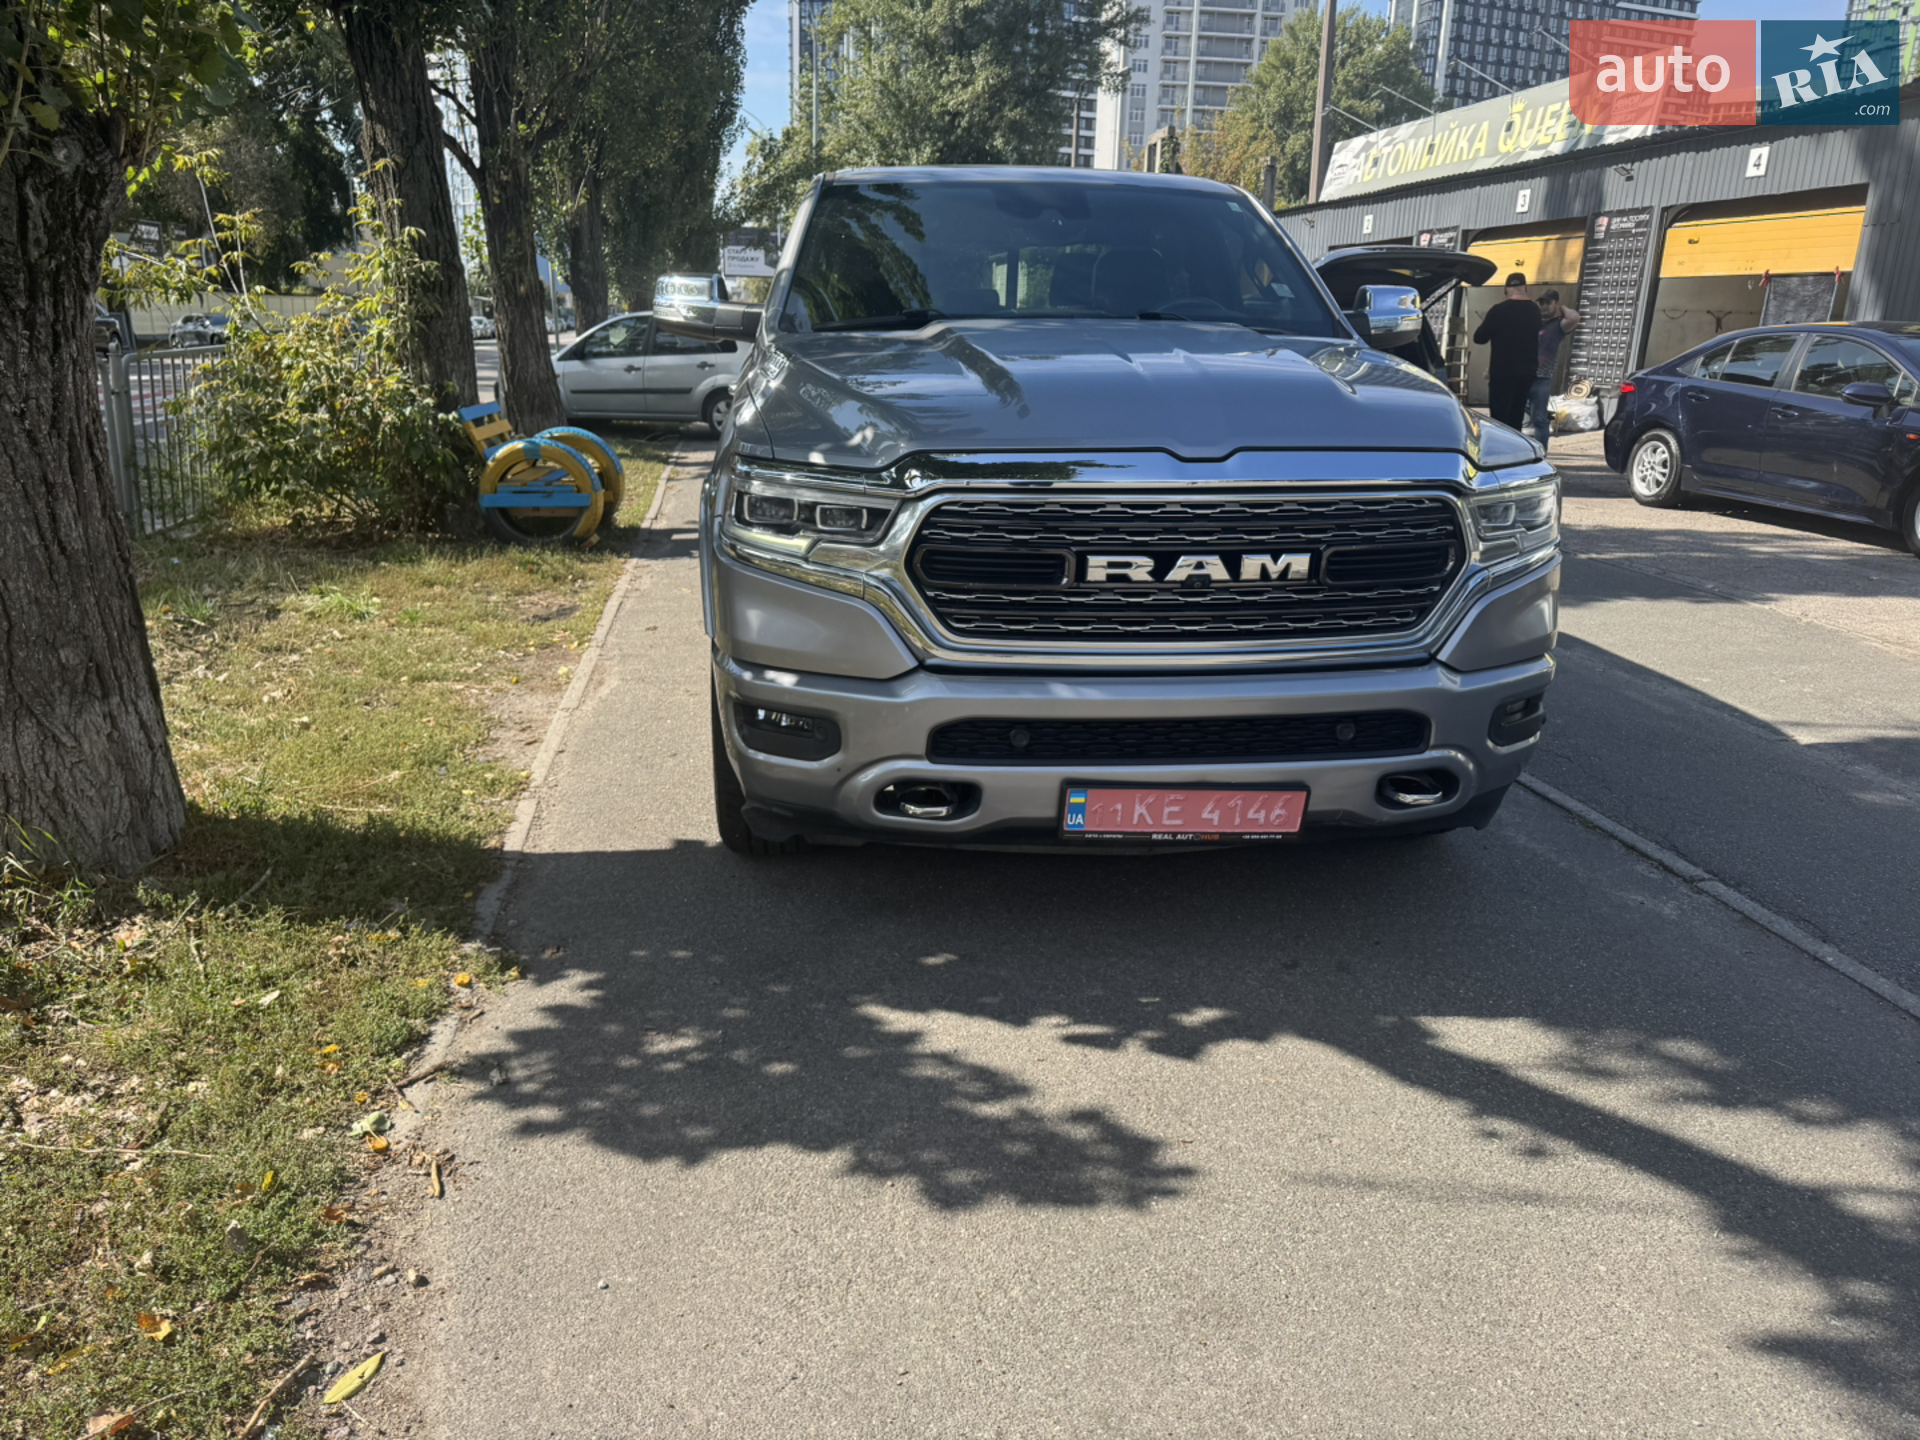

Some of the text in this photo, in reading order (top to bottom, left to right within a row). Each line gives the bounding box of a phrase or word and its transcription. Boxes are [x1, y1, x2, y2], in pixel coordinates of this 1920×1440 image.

[1752, 152, 1764, 171] 4
[1520, 193, 1528, 208] 3
[1086, 553, 1312, 582] RAM
[1066, 813, 1084, 825] UA
[1201, 794, 1294, 827] 4146
